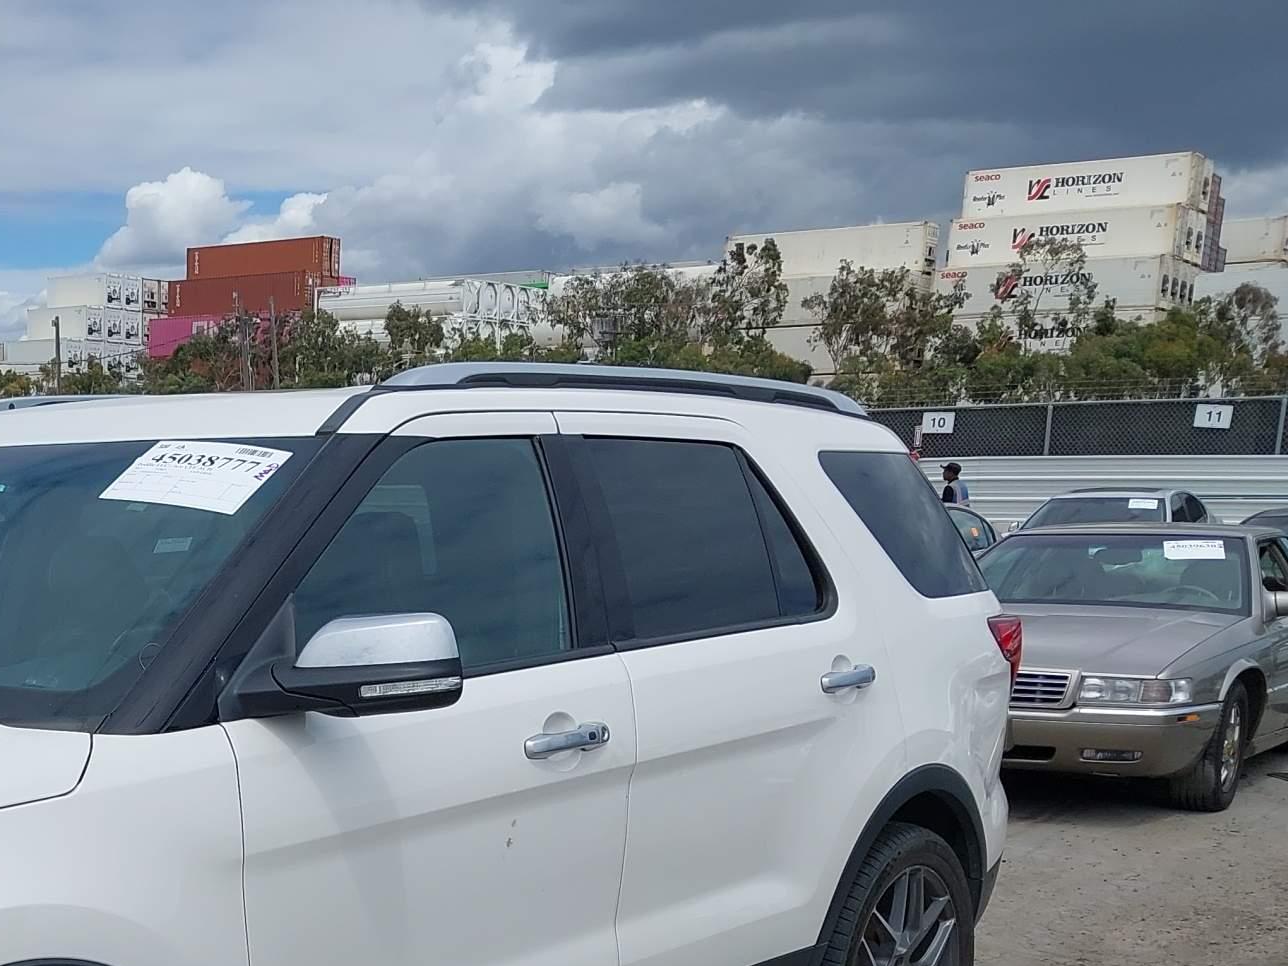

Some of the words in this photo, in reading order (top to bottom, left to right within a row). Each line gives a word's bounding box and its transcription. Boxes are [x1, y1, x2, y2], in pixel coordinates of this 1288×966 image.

[974, 173, 1001, 183] seaco
[1054, 172, 1124, 188] HORIZON
[1053, 185, 1112, 196] LINES
[958, 222, 986, 231] seaco
[1039, 221, 1109, 237] HORIZON
[940, 271, 968, 280] seaco
[1023, 272, 1093, 287] HORIZON
[930, 417, 946, 428] 10
[1206, 410, 1222, 423] 11
[152, 452, 261, 473] 45038777
